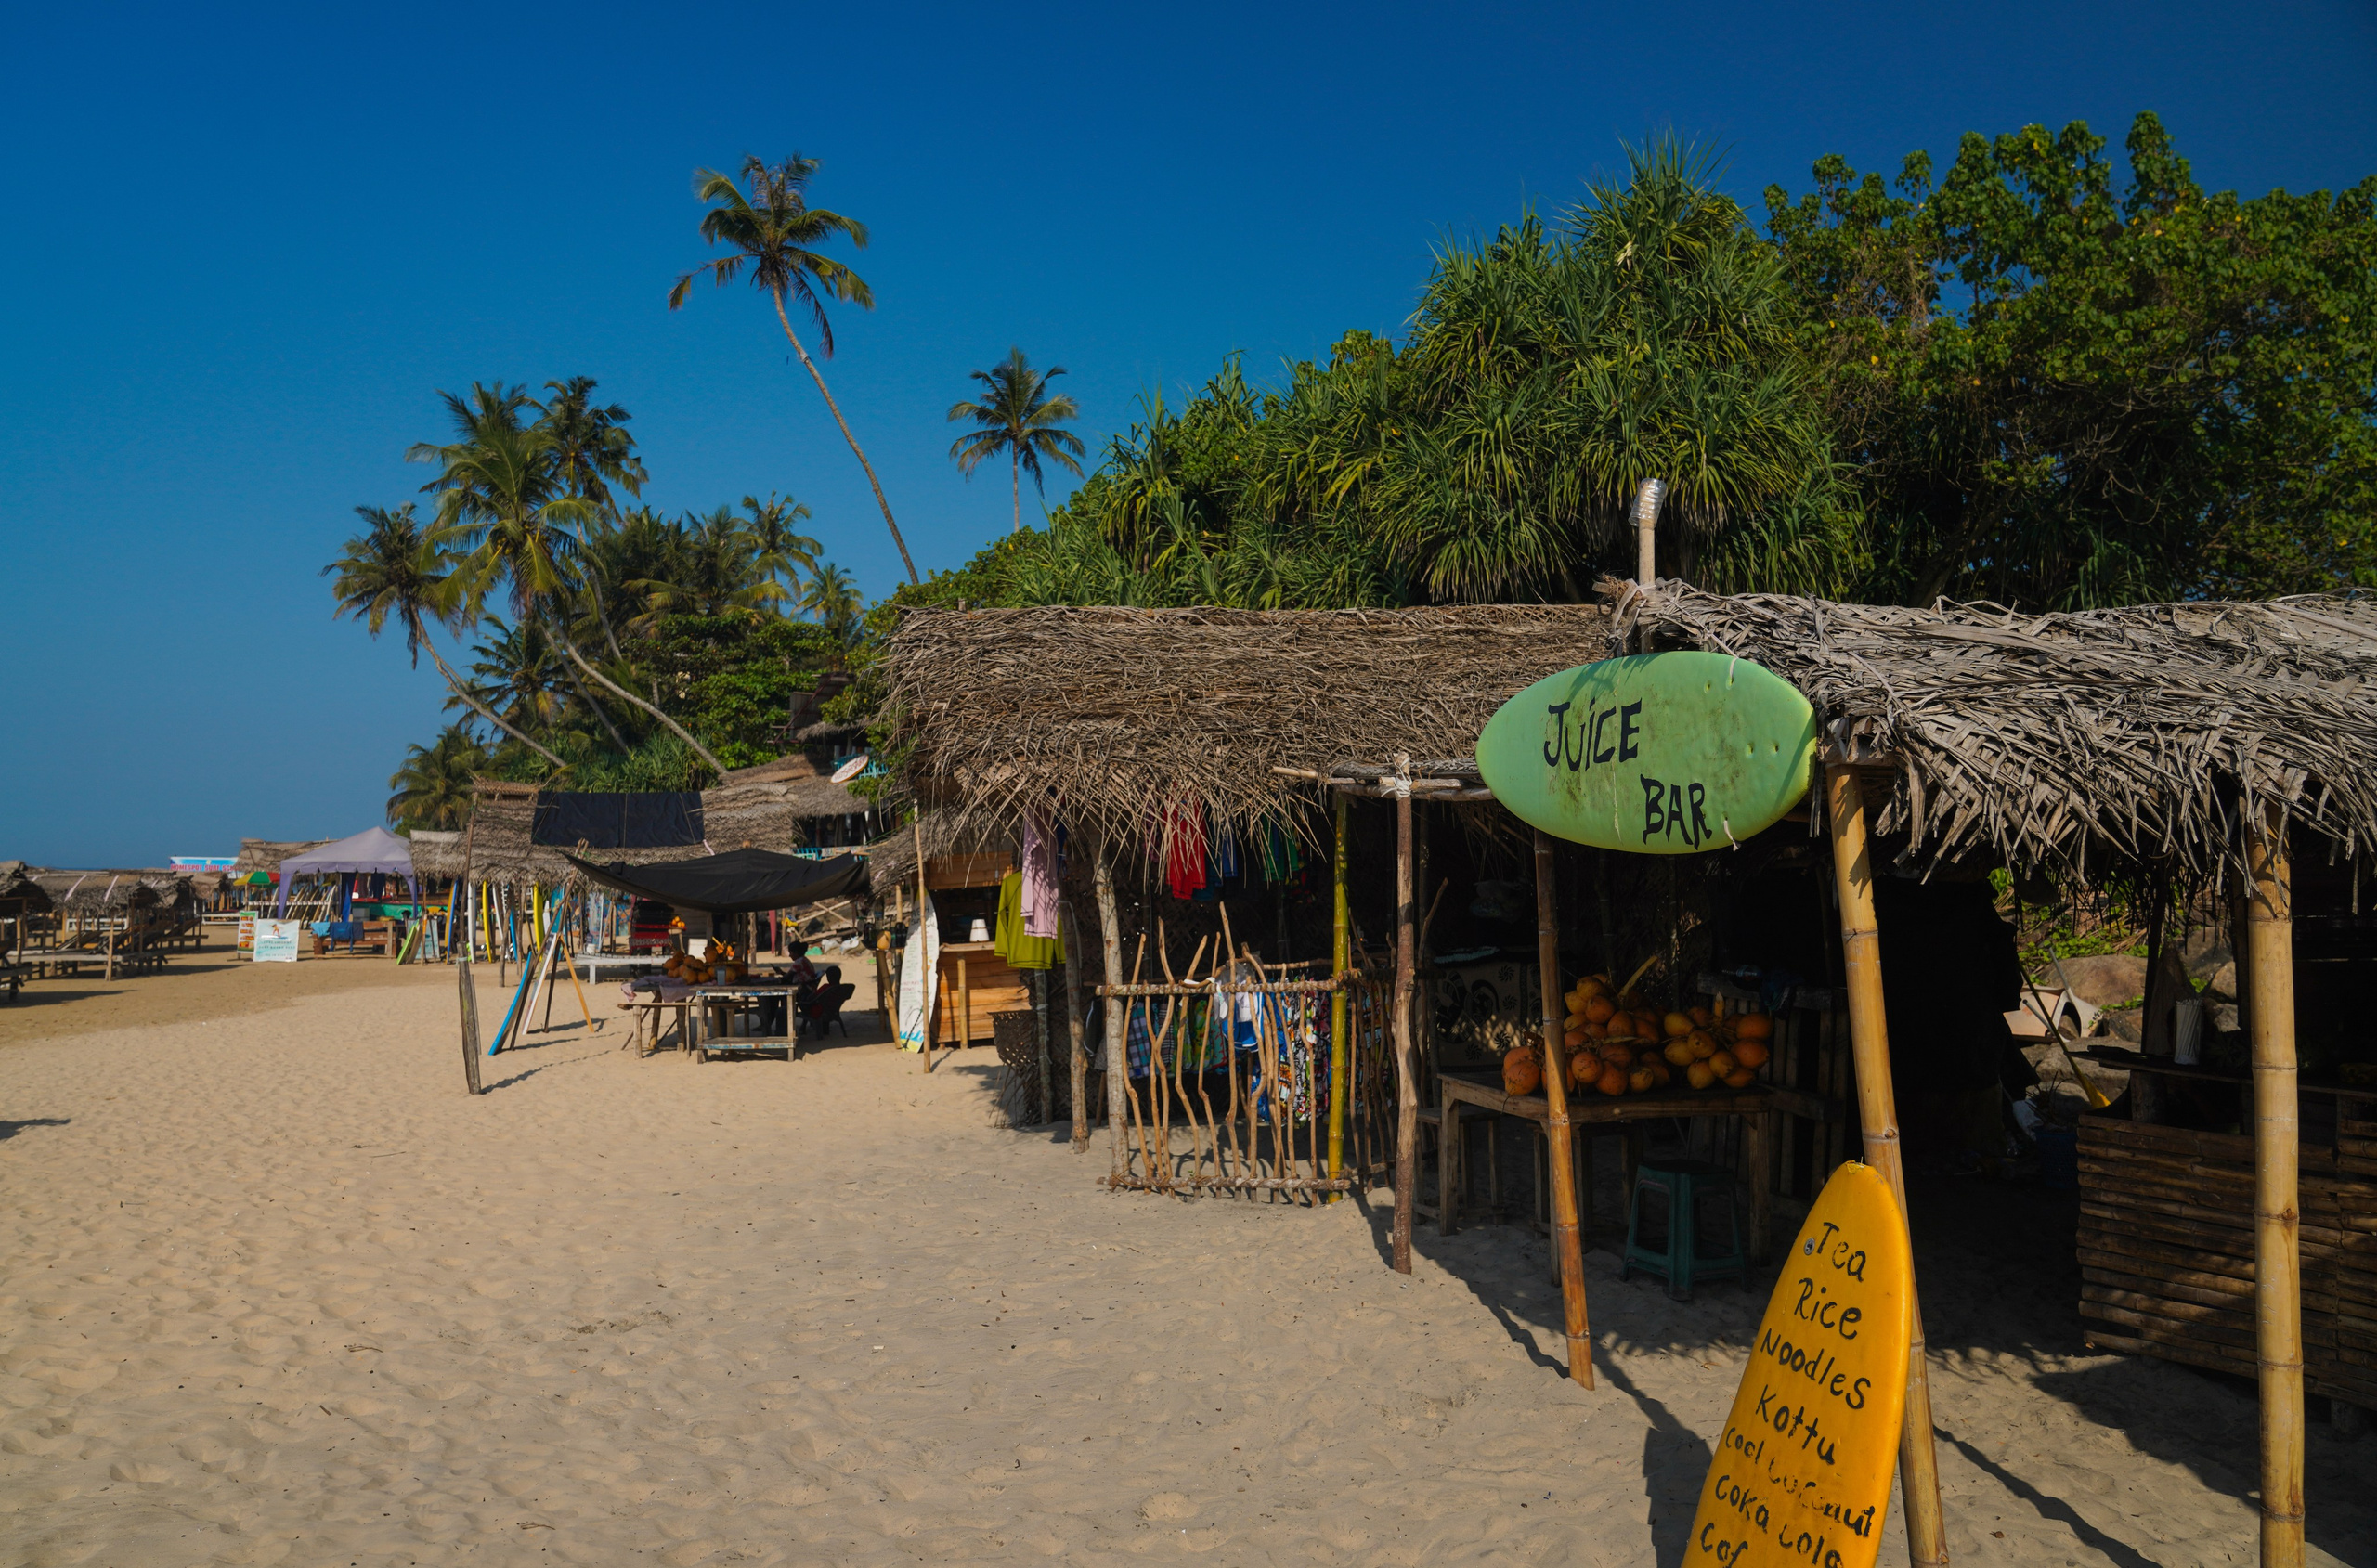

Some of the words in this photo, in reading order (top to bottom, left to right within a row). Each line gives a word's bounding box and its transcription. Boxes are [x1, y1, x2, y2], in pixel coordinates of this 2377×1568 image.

[1640, 774, 1713, 850] BAR
[1817, 1222, 1866, 1283] Tea
[1794, 1277, 1862, 1340] Rice
[1755, 1384, 1835, 1465] Kottu
